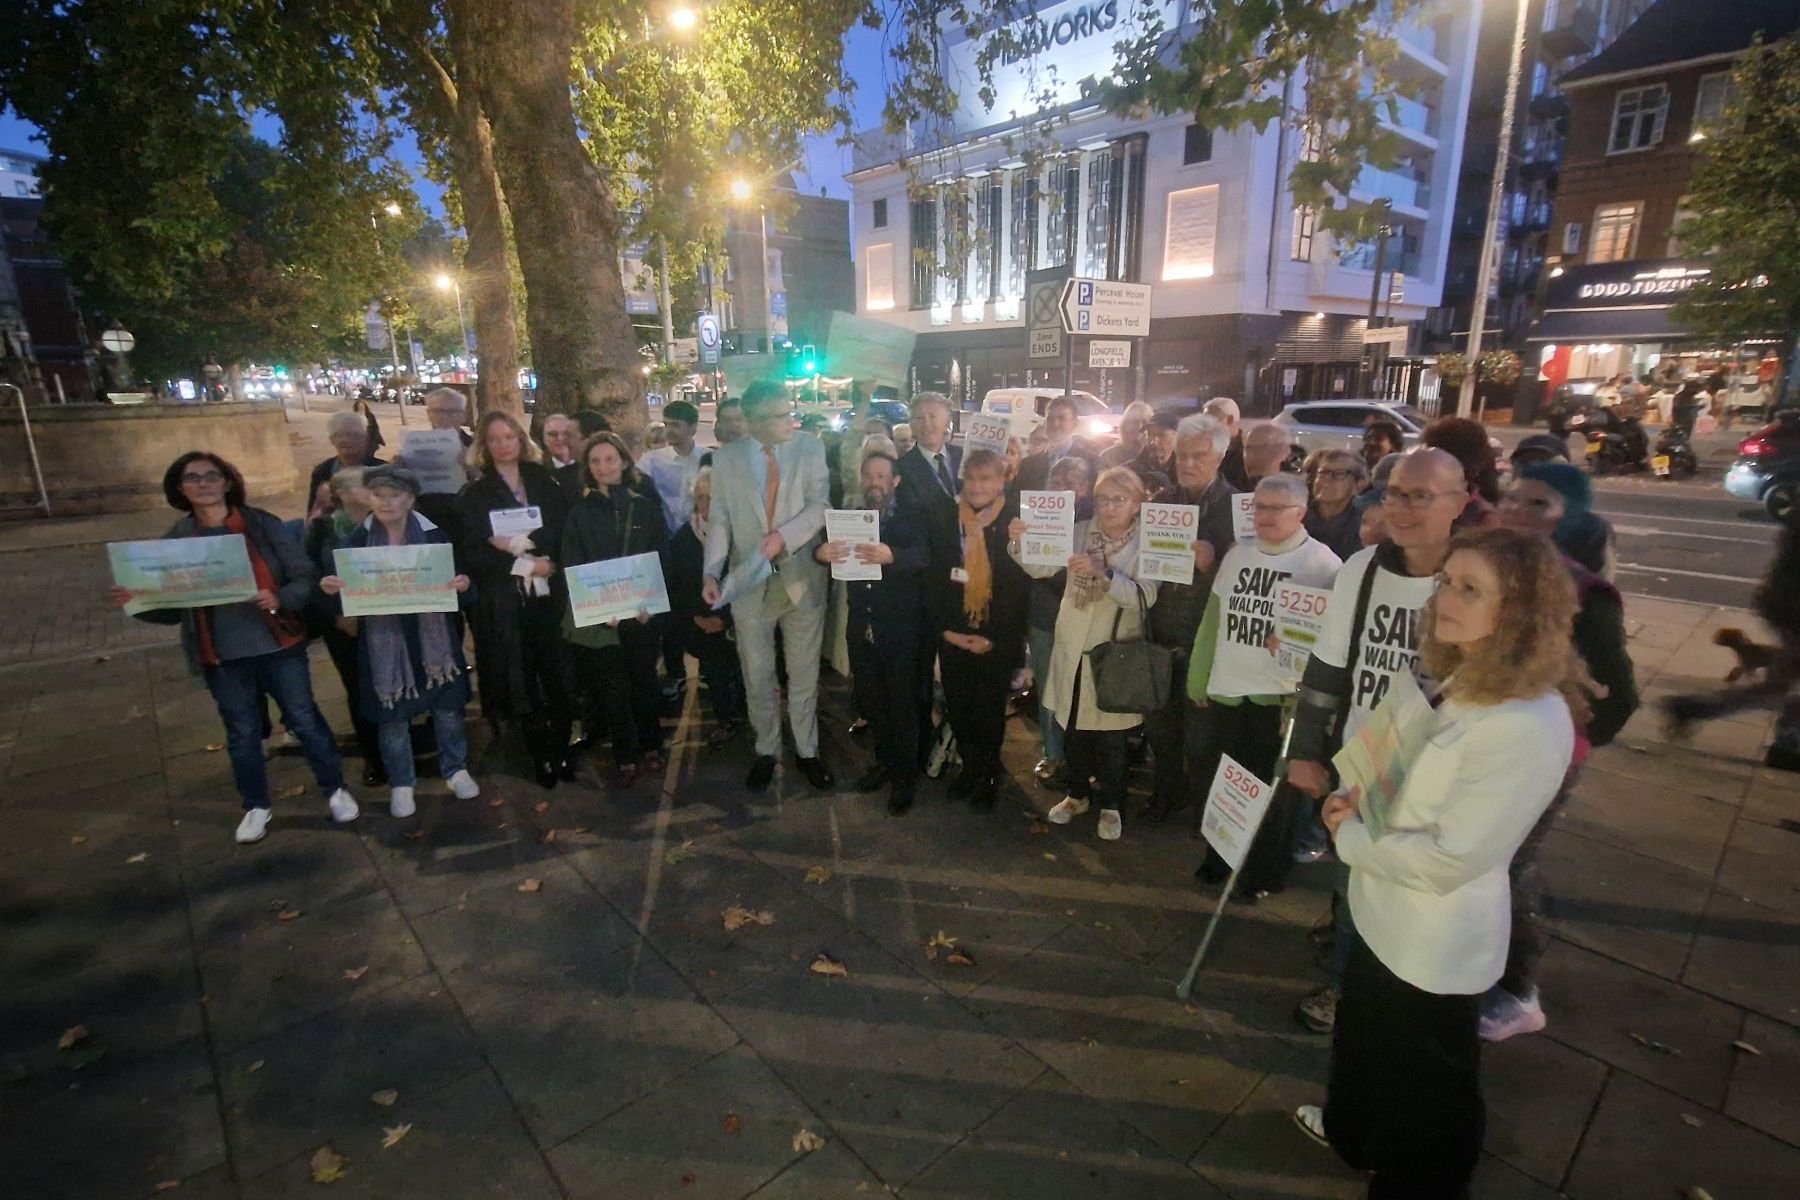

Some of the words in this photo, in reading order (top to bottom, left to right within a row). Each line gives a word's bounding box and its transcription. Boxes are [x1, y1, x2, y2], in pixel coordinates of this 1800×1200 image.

[988, 0, 1117, 68] ILMWORKS
[1126, 288, 1144, 299] House
[1097, 315, 1122, 326] Dickens
[1125, 317, 1139, 327] Yard
[1037, 333, 1052, 341] Zone
[1032, 343, 1057, 354] ENDS
[971, 422, 1006, 441] 5250
[1028, 496, 1066, 509] 5250
[1145, 508, 1193, 527] 5250
[1229, 595, 1275, 618] WALPOL
[1280, 589, 1327, 616] 5250
[1368, 604, 1419, 651] SA
[1365, 645, 1421, 674] WALP
[1357, 669, 1391, 711] PA
[1224, 764, 1260, 799] 5250
